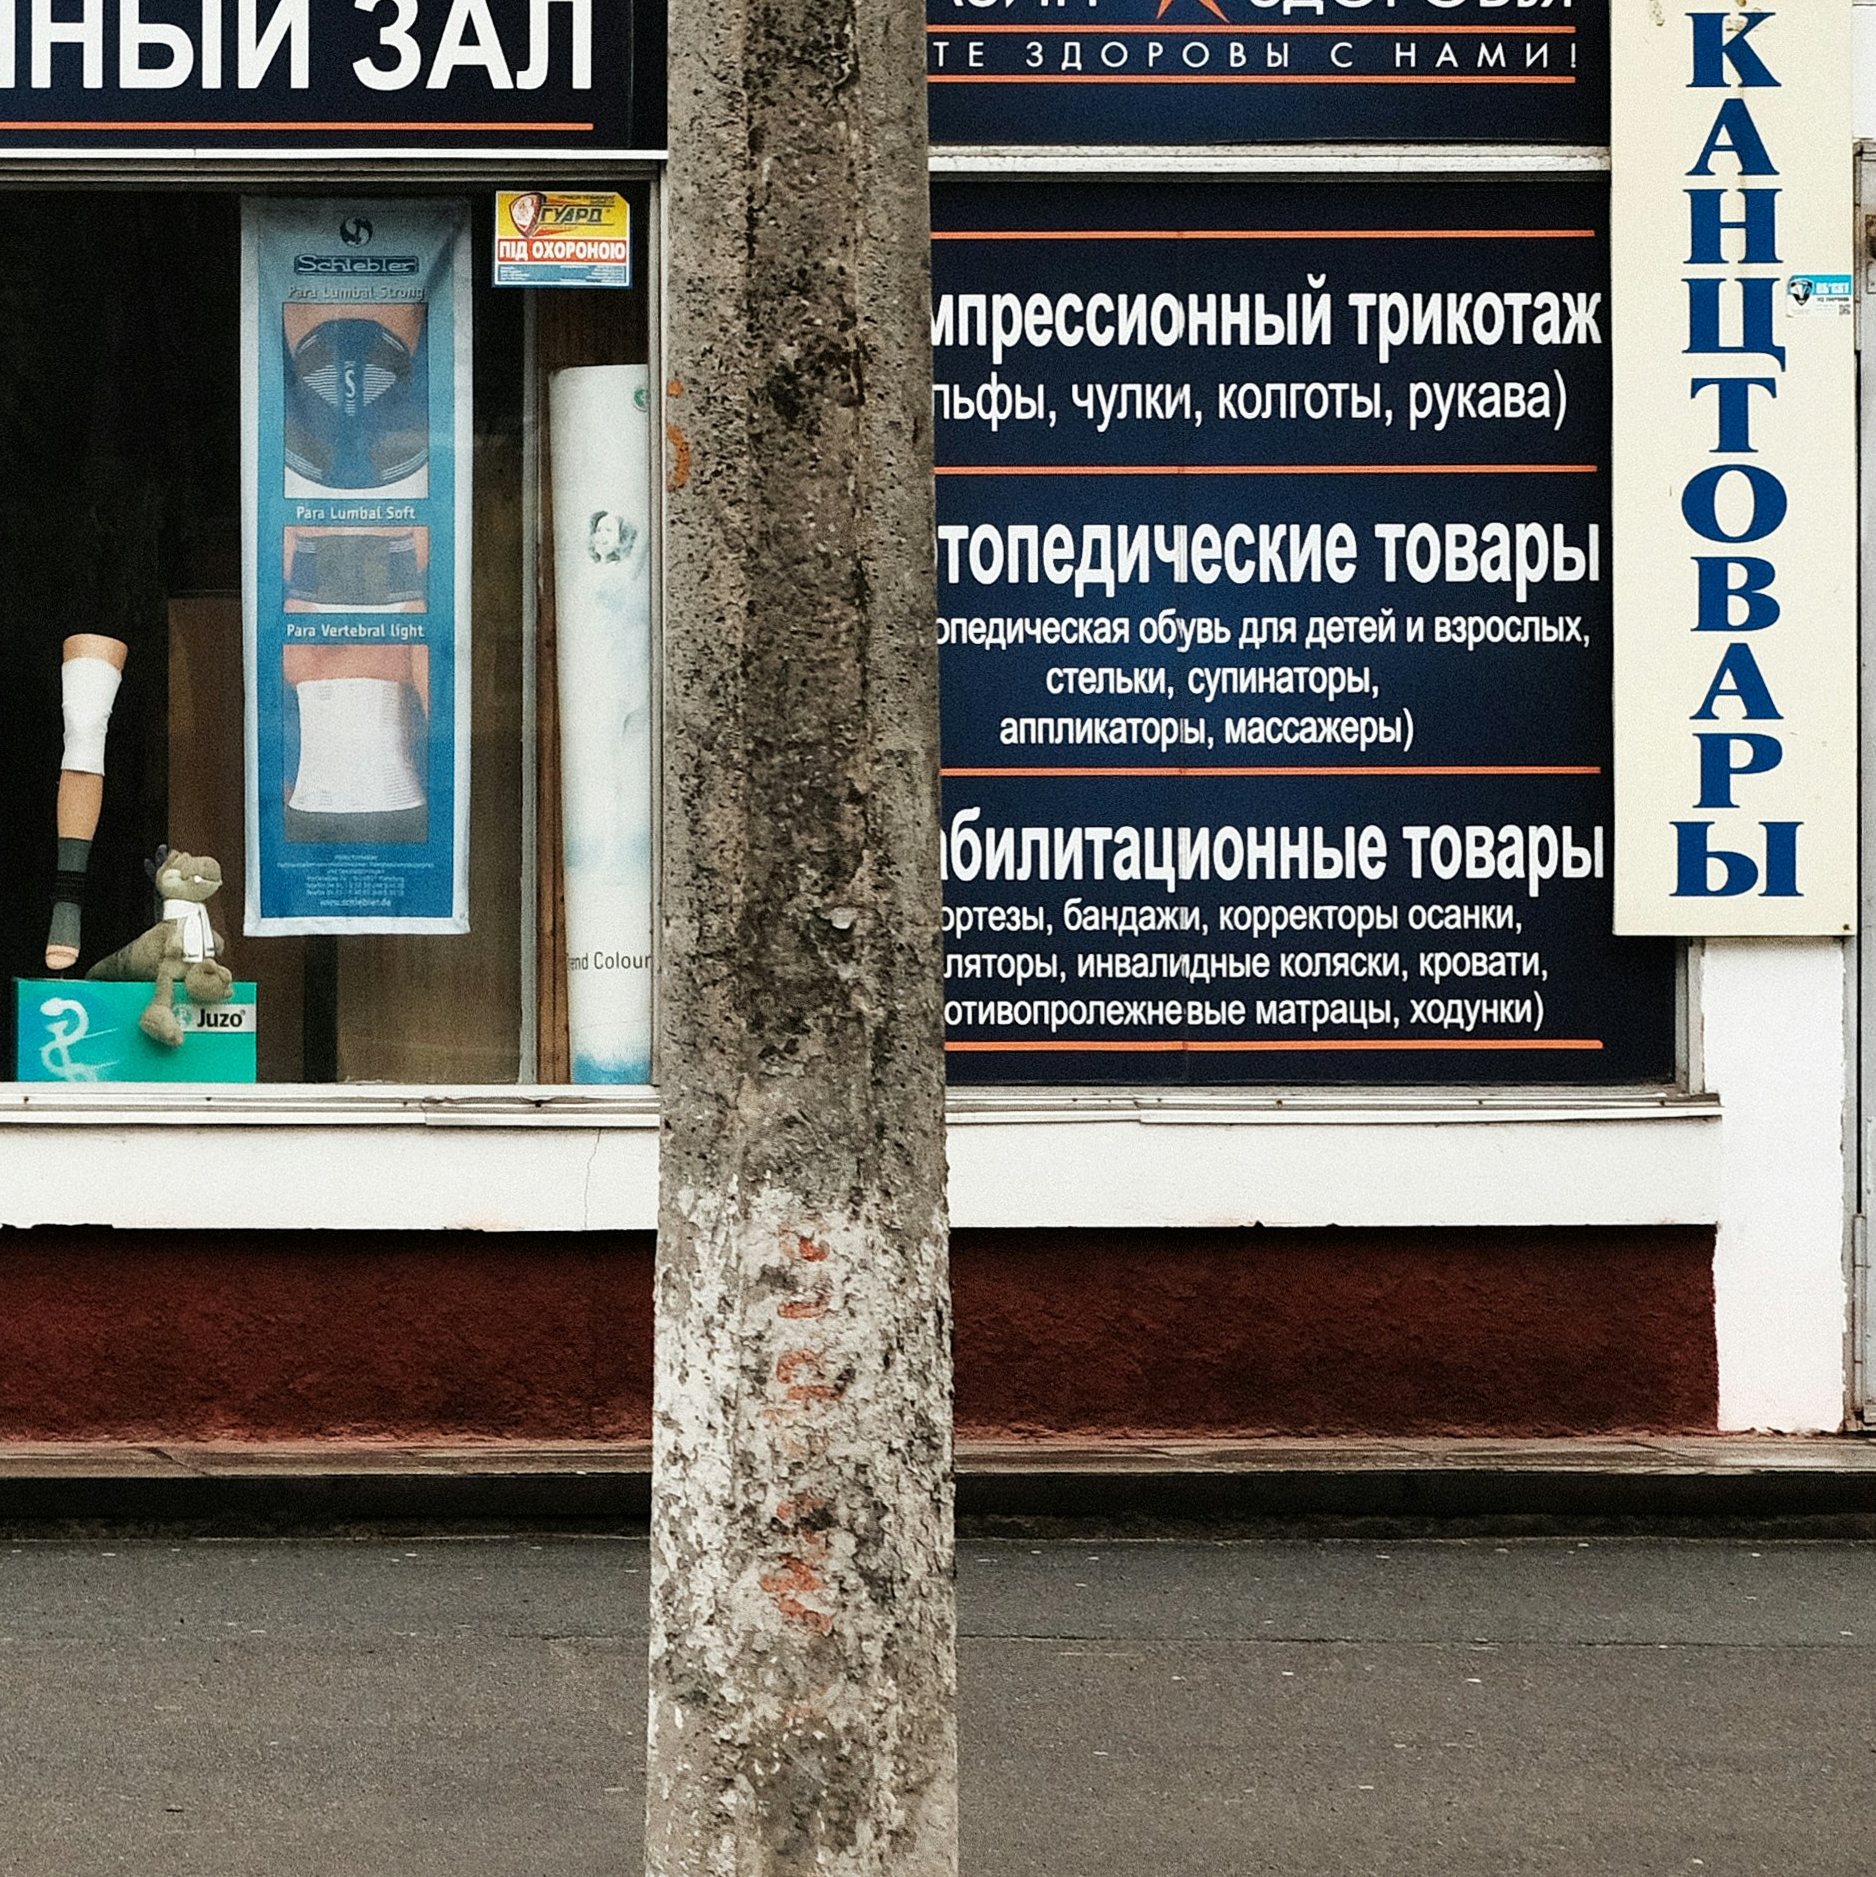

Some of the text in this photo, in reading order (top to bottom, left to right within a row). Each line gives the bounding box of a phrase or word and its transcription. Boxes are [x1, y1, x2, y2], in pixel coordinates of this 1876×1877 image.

[1026, 40, 1289, 71] ЗДОРОВЫ
[1330, 40, 1354, 68] С
[1395, 40, 1578, 68] НАМИ!
[499, 240, 626, 260] ПІД ОХОРОНОЮ
[287, 285, 318, 299] Para
[322, 285, 373, 299] Lumbal
[1348, 290, 1603, 364] трикотаж
[1071, 382, 1203, 433] чулки,
[1217, 382, 1394, 426] колготы,
[1408, 370, 1567, 431] рукава)
[1668, 12, 1805, 897] КАНЦТОВАРЫ
[296, 507, 416, 520] Para Lumbal Soft
[933, 522, 1600, 602] топедические товары
[286, 624, 425, 640] Para Vertebral light
[1138, 609, 1232, 652] обувь
[1238, 614, 1297, 648] для
[1304, 610, 1397, 648] детей
[1405, 615, 1425, 641] и
[1433, 612, 1591, 651] взрослых,
[1045, 666, 1379, 702] стельки, супинаторы,
[999, 707, 1415, 752] аппликаторы, массажеры)
[1402, 824, 1605, 896] товары
[1063, 898, 1210, 936] бандажи,
[1218, 903, 1398, 938] корректоры
[1407, 902, 1524, 935] осанки,
[1077, 950, 1271, 985] инвалидные
[1279, 950, 1409, 982] коляски,
[1418, 950, 1548, 987] кровати,
[196, 1008, 243, 1028] Juzo
[1255, 996, 1401, 1032] матрацы,
[1409, 990, 1545, 1031] ходунки)
